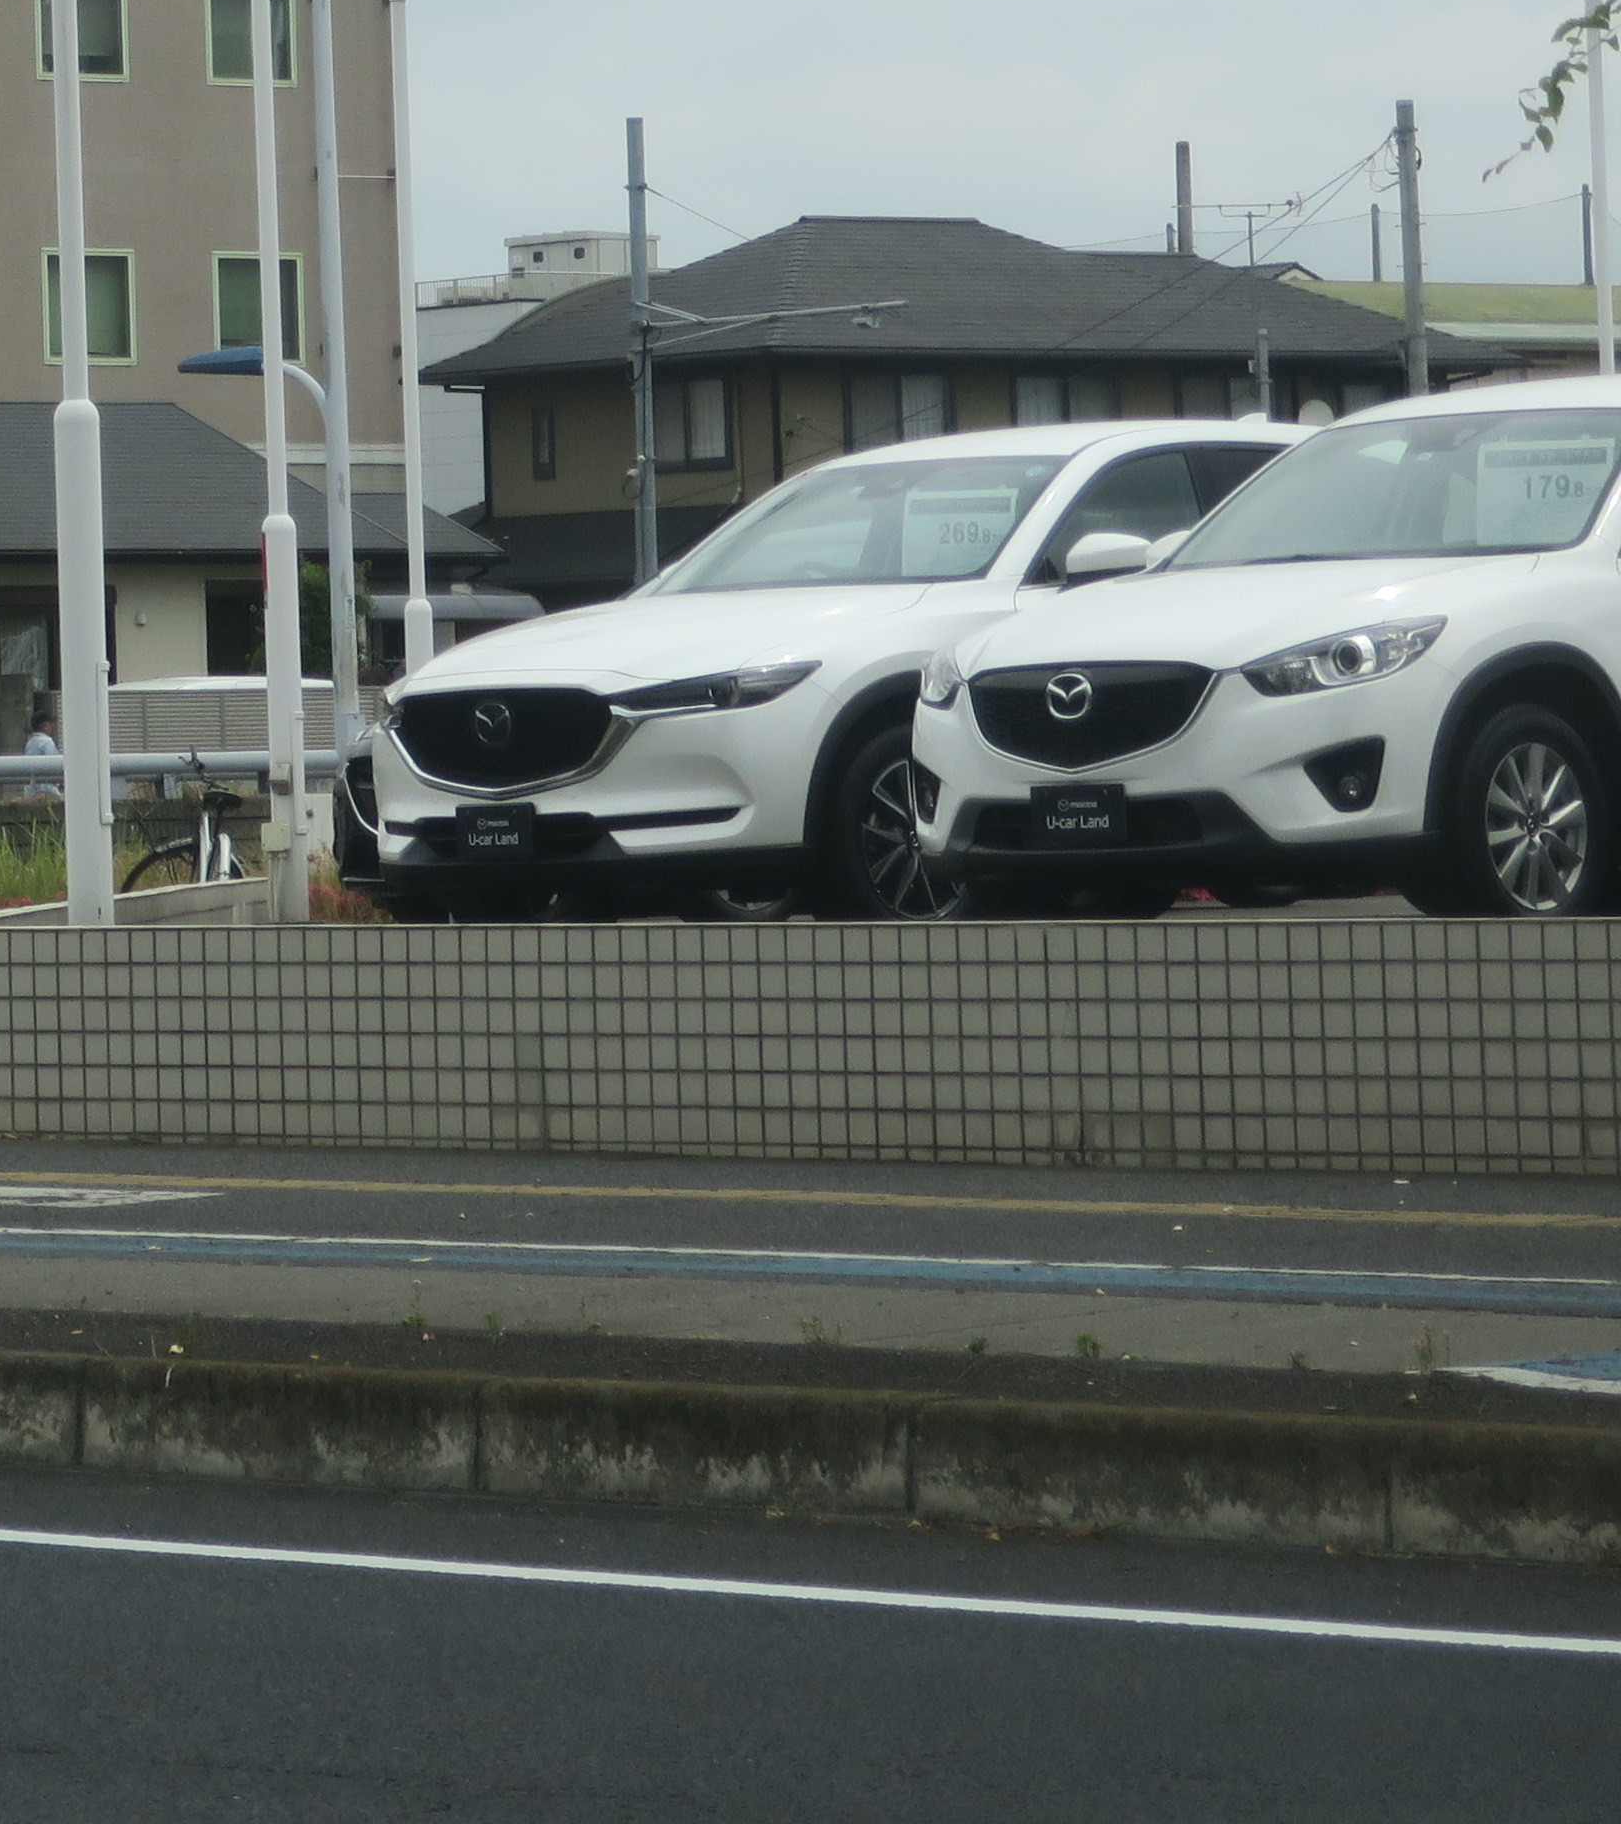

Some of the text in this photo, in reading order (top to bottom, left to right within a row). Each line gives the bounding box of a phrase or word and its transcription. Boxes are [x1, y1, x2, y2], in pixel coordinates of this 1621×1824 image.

[1046, 814, 1110, 829] U-car Land
[468, 832, 519, 846] U-car Land
